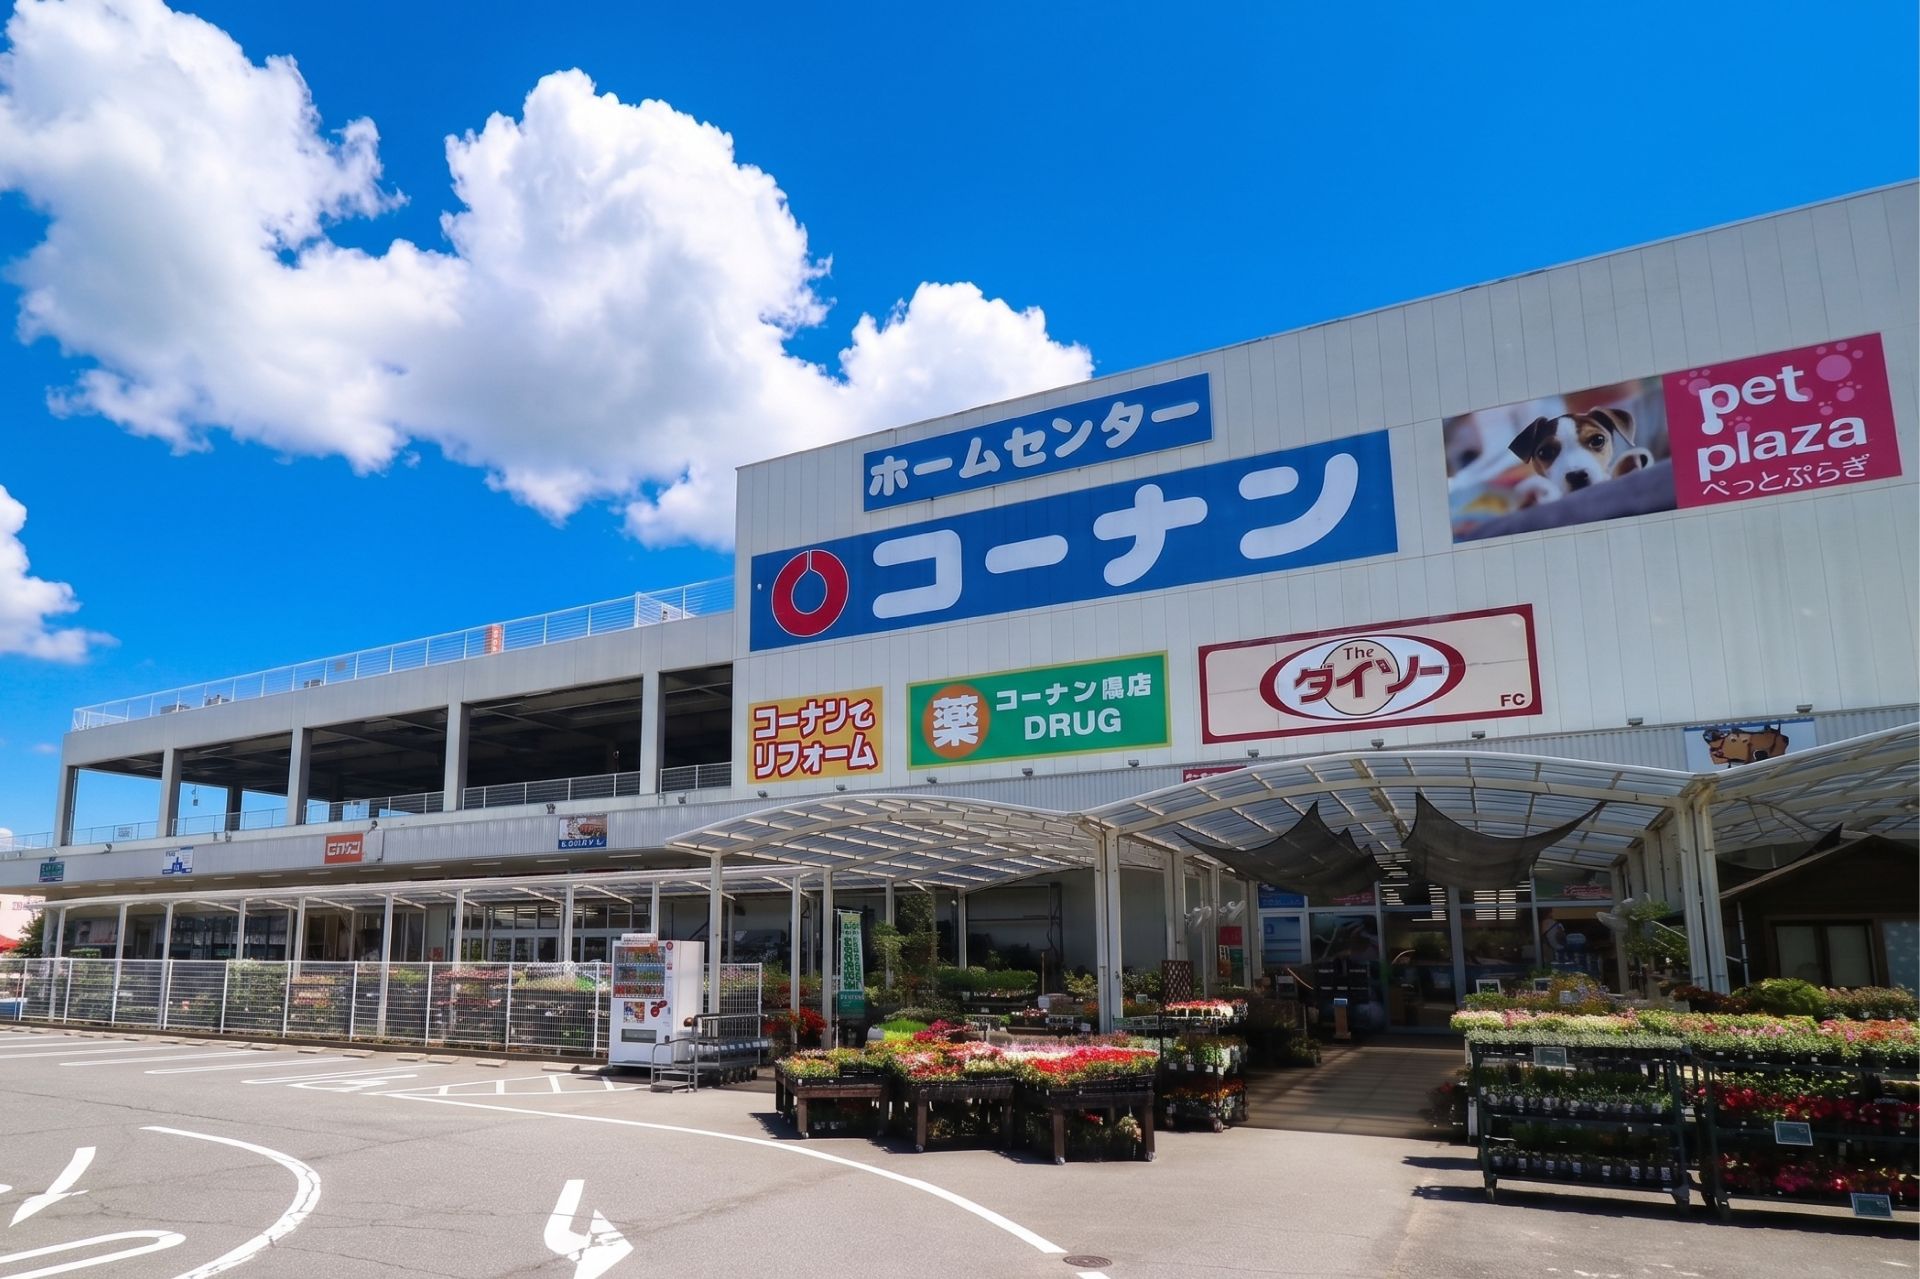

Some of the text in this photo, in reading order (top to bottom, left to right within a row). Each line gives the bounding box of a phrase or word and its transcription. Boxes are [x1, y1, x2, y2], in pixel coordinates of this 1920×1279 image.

[1698, 364, 1808, 435] pet
[869, 401, 1199, 496] ホームセンター
[1697, 416, 1867, 481] plaza
[872, 452, 1359, 619] コーナン
[1294, 654, 1445, 705] ダイソー
[1342, 646, 1375, 661] The
[932, 694, 979, 748] 薬
[1023, 707, 1122, 741] DRUG
[1499, 692, 1526, 708] FC
[754, 732, 878, 778] リフォーム
